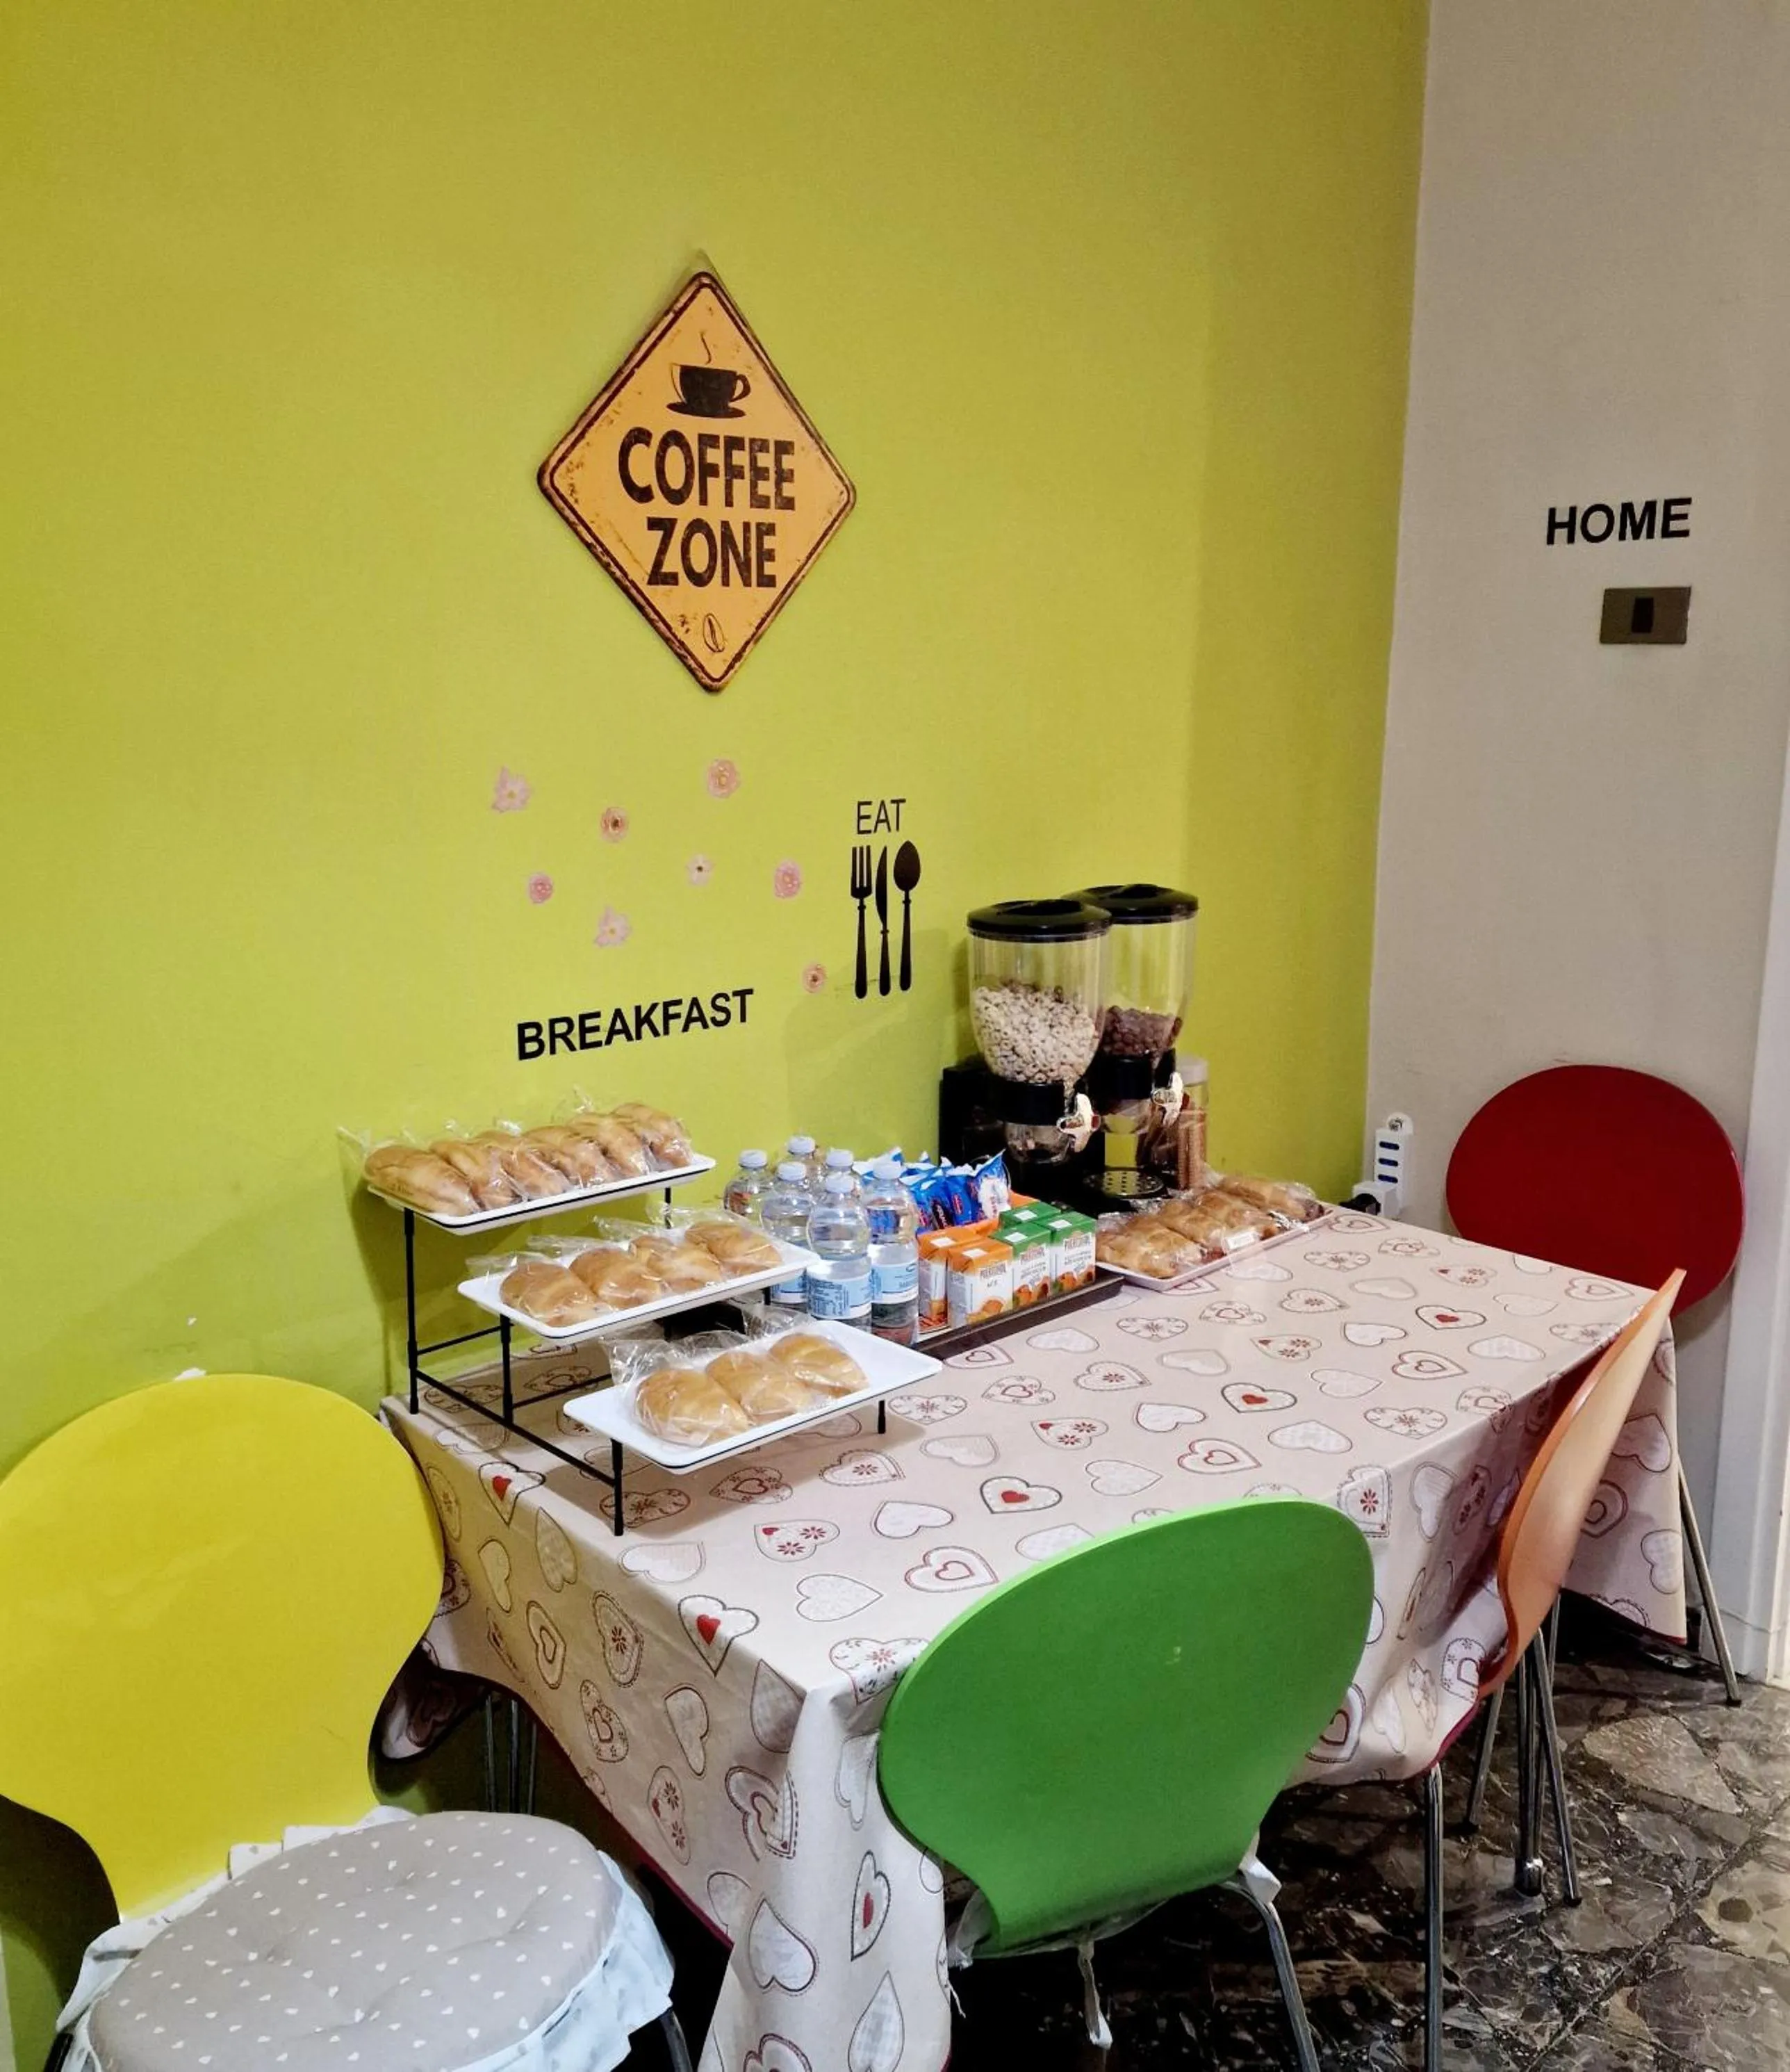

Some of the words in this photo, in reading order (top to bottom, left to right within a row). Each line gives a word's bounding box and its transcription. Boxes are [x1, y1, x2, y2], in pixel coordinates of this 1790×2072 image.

[618, 427, 795, 511] COFFEE
[646, 517, 776, 587] ZONE
[1546, 497, 1692, 546] HOME
[856, 798, 907, 835] EAT
[517, 988, 754, 1061] BREAKFAST
